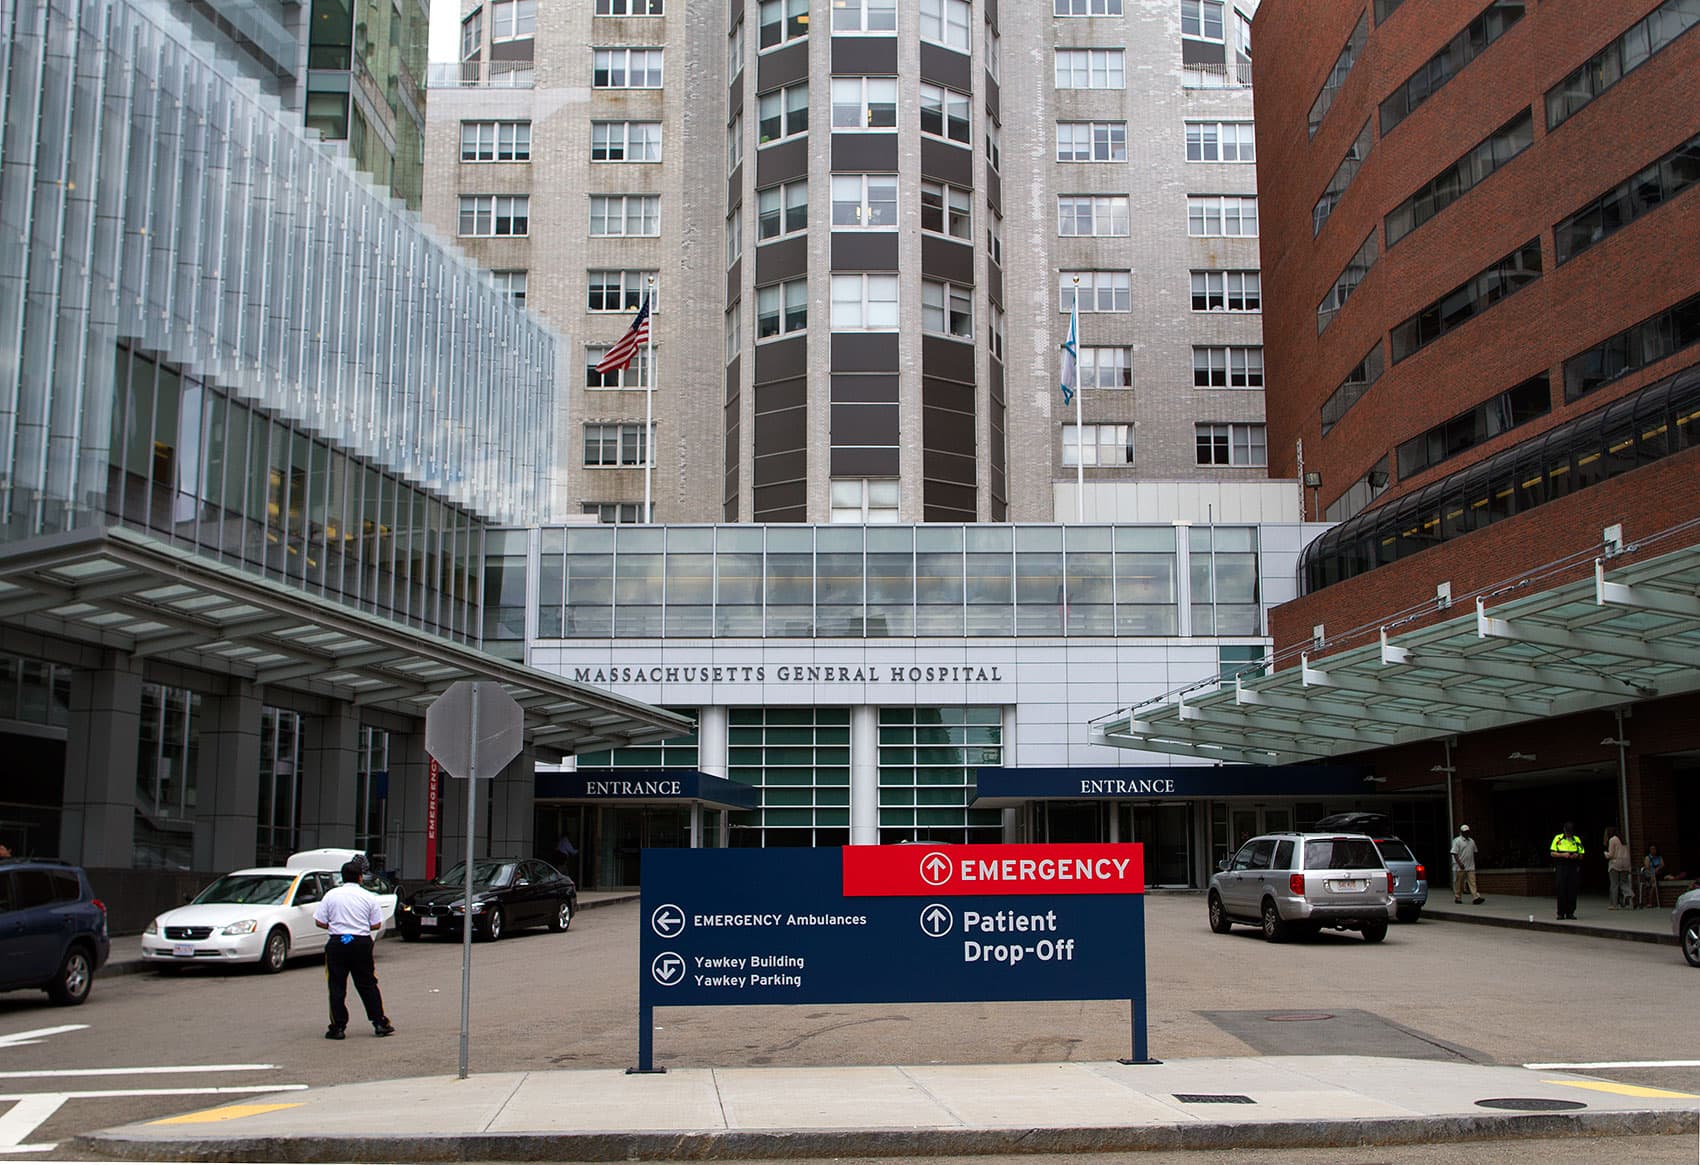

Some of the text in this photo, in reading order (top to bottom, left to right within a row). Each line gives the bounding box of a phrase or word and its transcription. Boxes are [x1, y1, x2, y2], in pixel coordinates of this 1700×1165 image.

[574, 666, 1002, 682] MASSACHUSETTS GENERAL HOSPITAL
[585, 780, 681, 796] ENTRANCE
[1080, 779, 1175, 794] ENTRANCE
[960, 858, 1130, 881] EMERGENCY
[693, 913, 867, 926] EMERGENCY Ambulances
[963, 909, 1057, 933] Patient
[964, 938, 1075, 966] Drop-Off
[694, 956, 805, 969] Yawkey Building
[694, 974, 802, 988] Yawkey Parking
